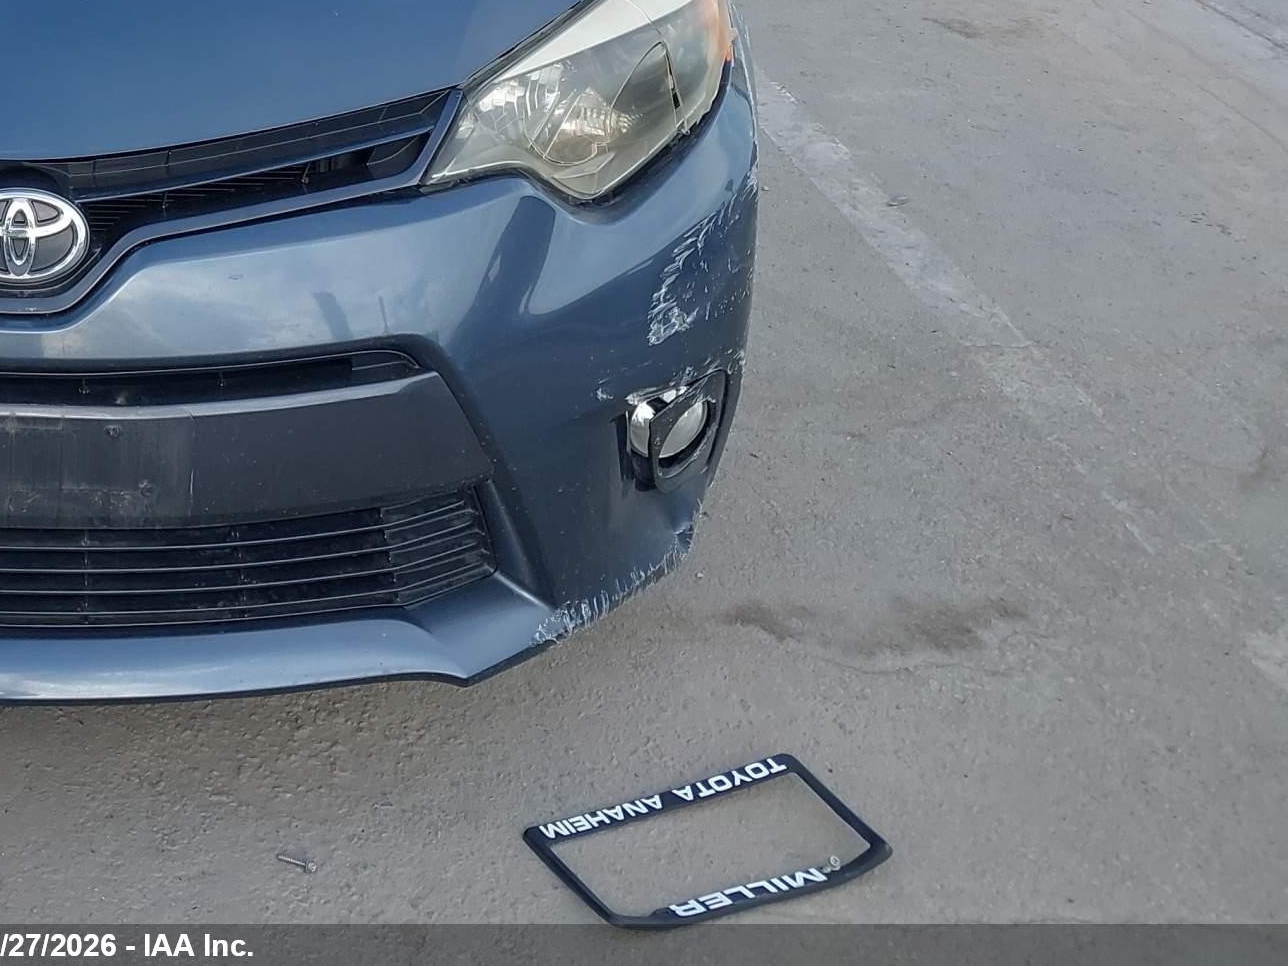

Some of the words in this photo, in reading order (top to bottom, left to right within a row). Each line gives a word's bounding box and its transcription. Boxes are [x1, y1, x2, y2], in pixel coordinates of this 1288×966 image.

[672, 757, 788, 802] TOYOTA
[539, 794, 663, 840] ANAHEIM
[669, 867, 828, 918] MILLER
